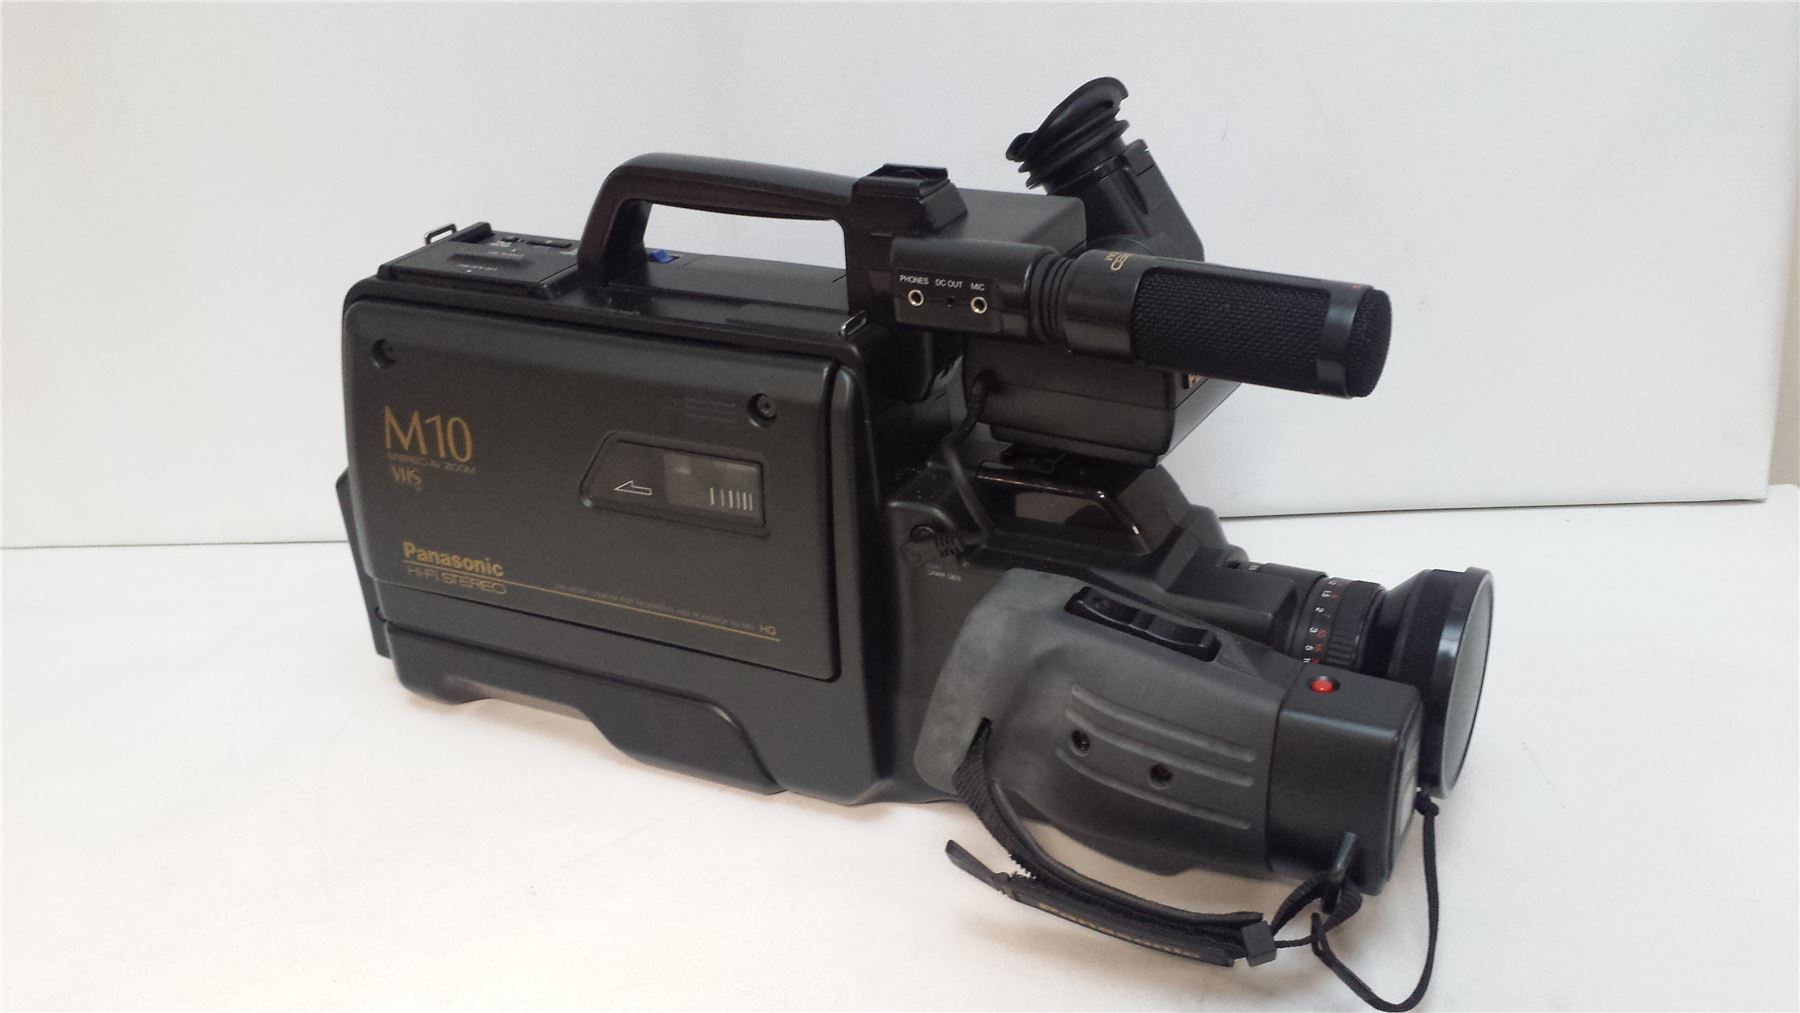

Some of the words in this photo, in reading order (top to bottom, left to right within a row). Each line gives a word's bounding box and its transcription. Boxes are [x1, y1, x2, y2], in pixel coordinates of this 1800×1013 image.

[899, 274, 930, 285] PHONES
[934, 278, 947, 287] DC
[947, 279, 963, 288] OUT
[969, 281, 986, 291] MIC
[383, 405, 473, 463] M10
[389, 463, 423, 486] VHS
[402, 540, 504, 577] Panasonic
[440, 571, 507, 595] STEREO
